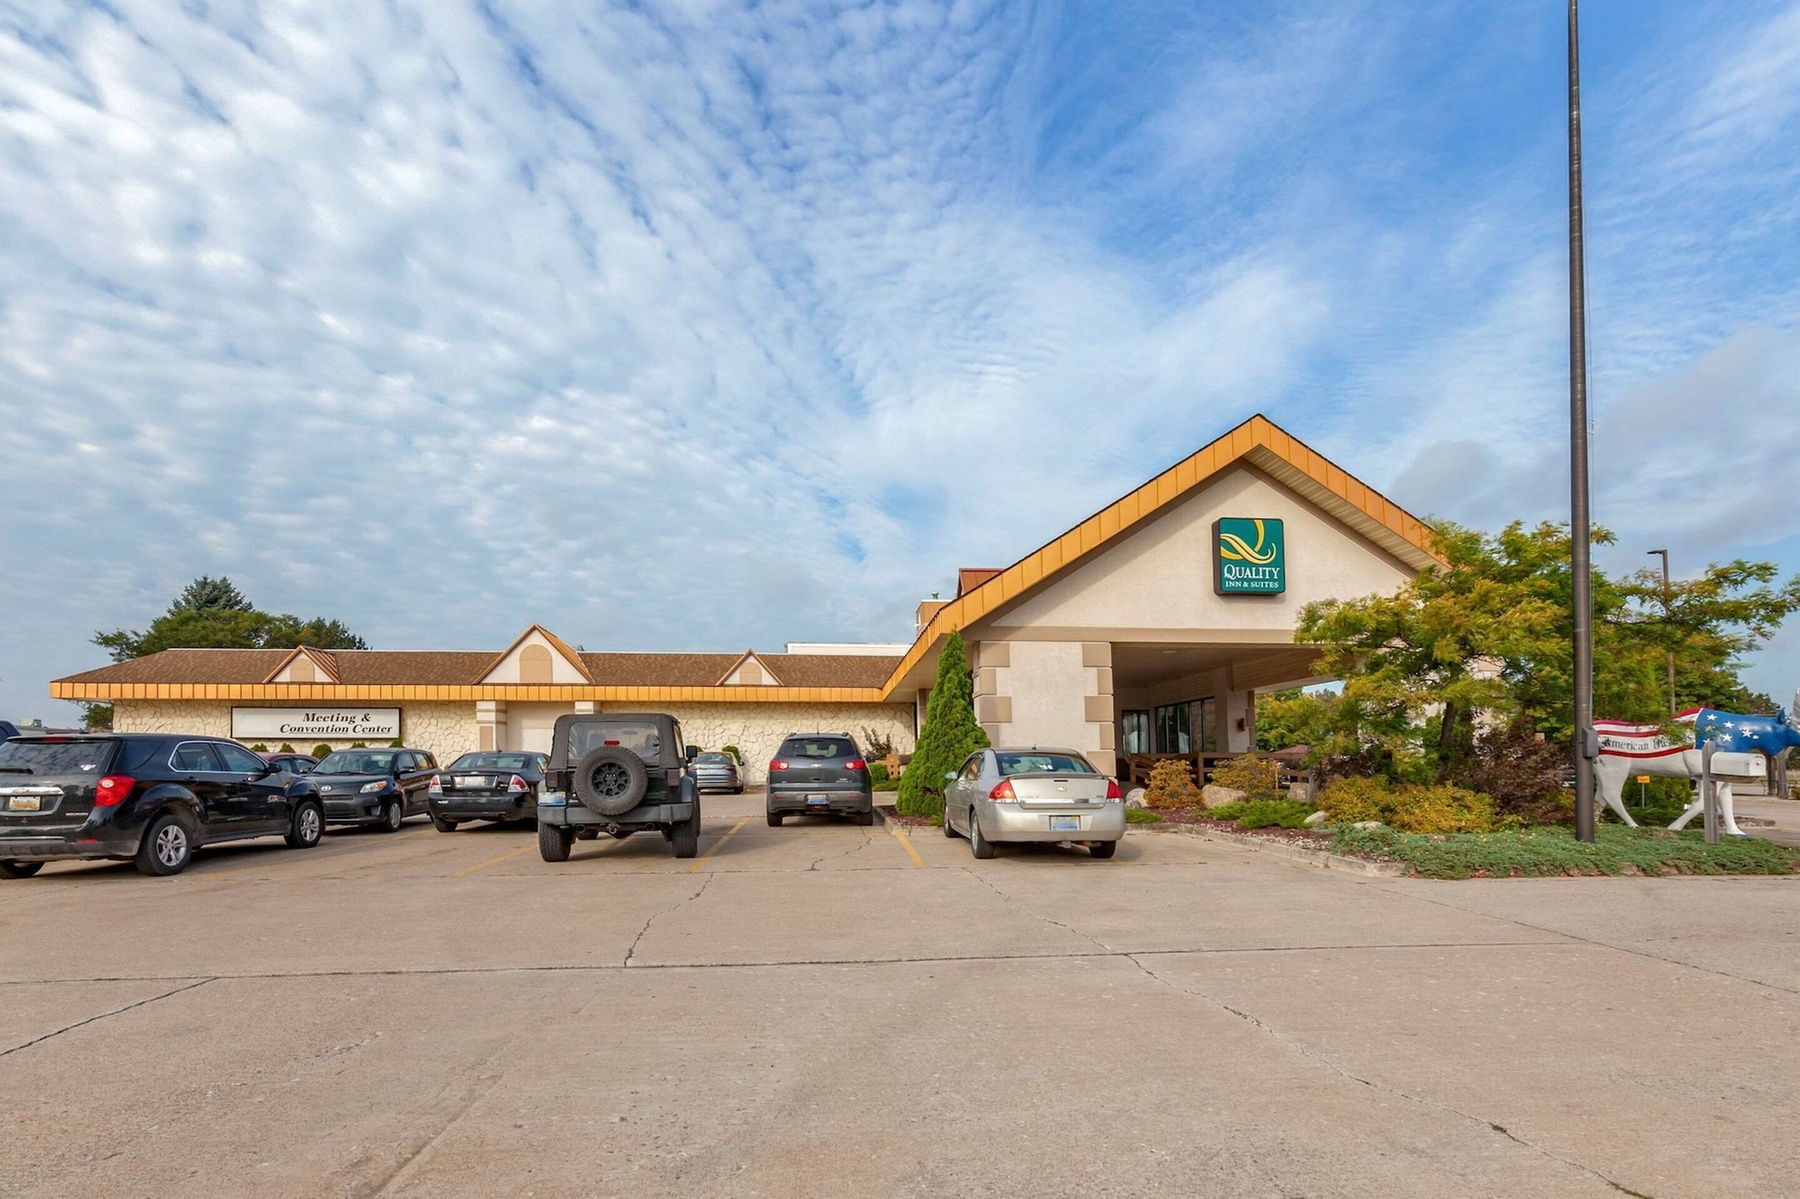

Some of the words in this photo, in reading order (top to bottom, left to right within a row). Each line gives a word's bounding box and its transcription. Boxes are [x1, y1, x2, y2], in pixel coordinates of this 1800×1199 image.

[1224, 564, 1280, 580] QUALITY
[1250, 581, 1279, 589] SUITES
[303, 713, 356, 724] Meeting
[361, 713, 371, 722] &
[280, 724, 349, 733] Convention
[352, 724, 393, 733] Center
